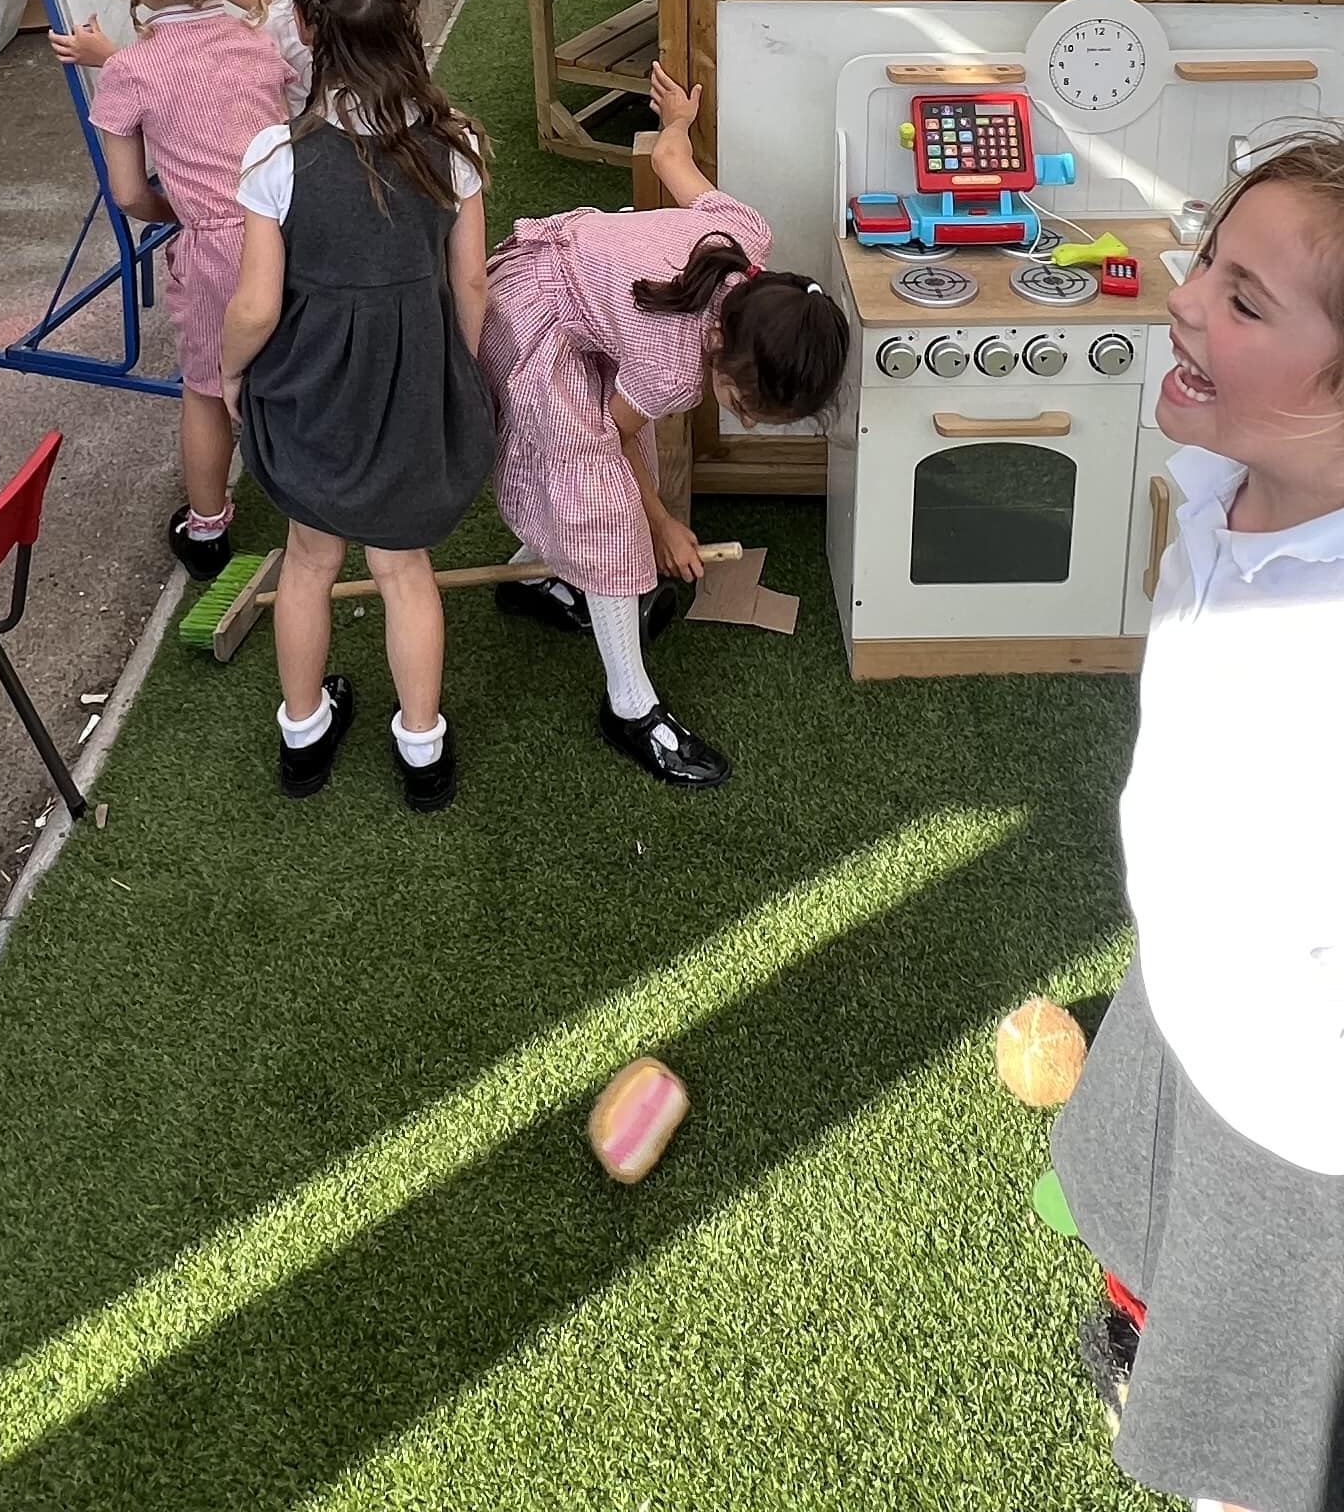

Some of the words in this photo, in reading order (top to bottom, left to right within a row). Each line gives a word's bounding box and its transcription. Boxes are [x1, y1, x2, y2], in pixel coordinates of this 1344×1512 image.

[1076, 31, 1086, 40] 11
[1094, 27, 1106, 36] 12
[1063, 44, 1074, 53] 10
[1126, 43, 1133, 52] 2
[1058, 61, 1065, 69] 9
[1128, 60, 1136, 68] 3
[1063, 77, 1070, 86] 8
[1111, 88, 1118, 97] 5
